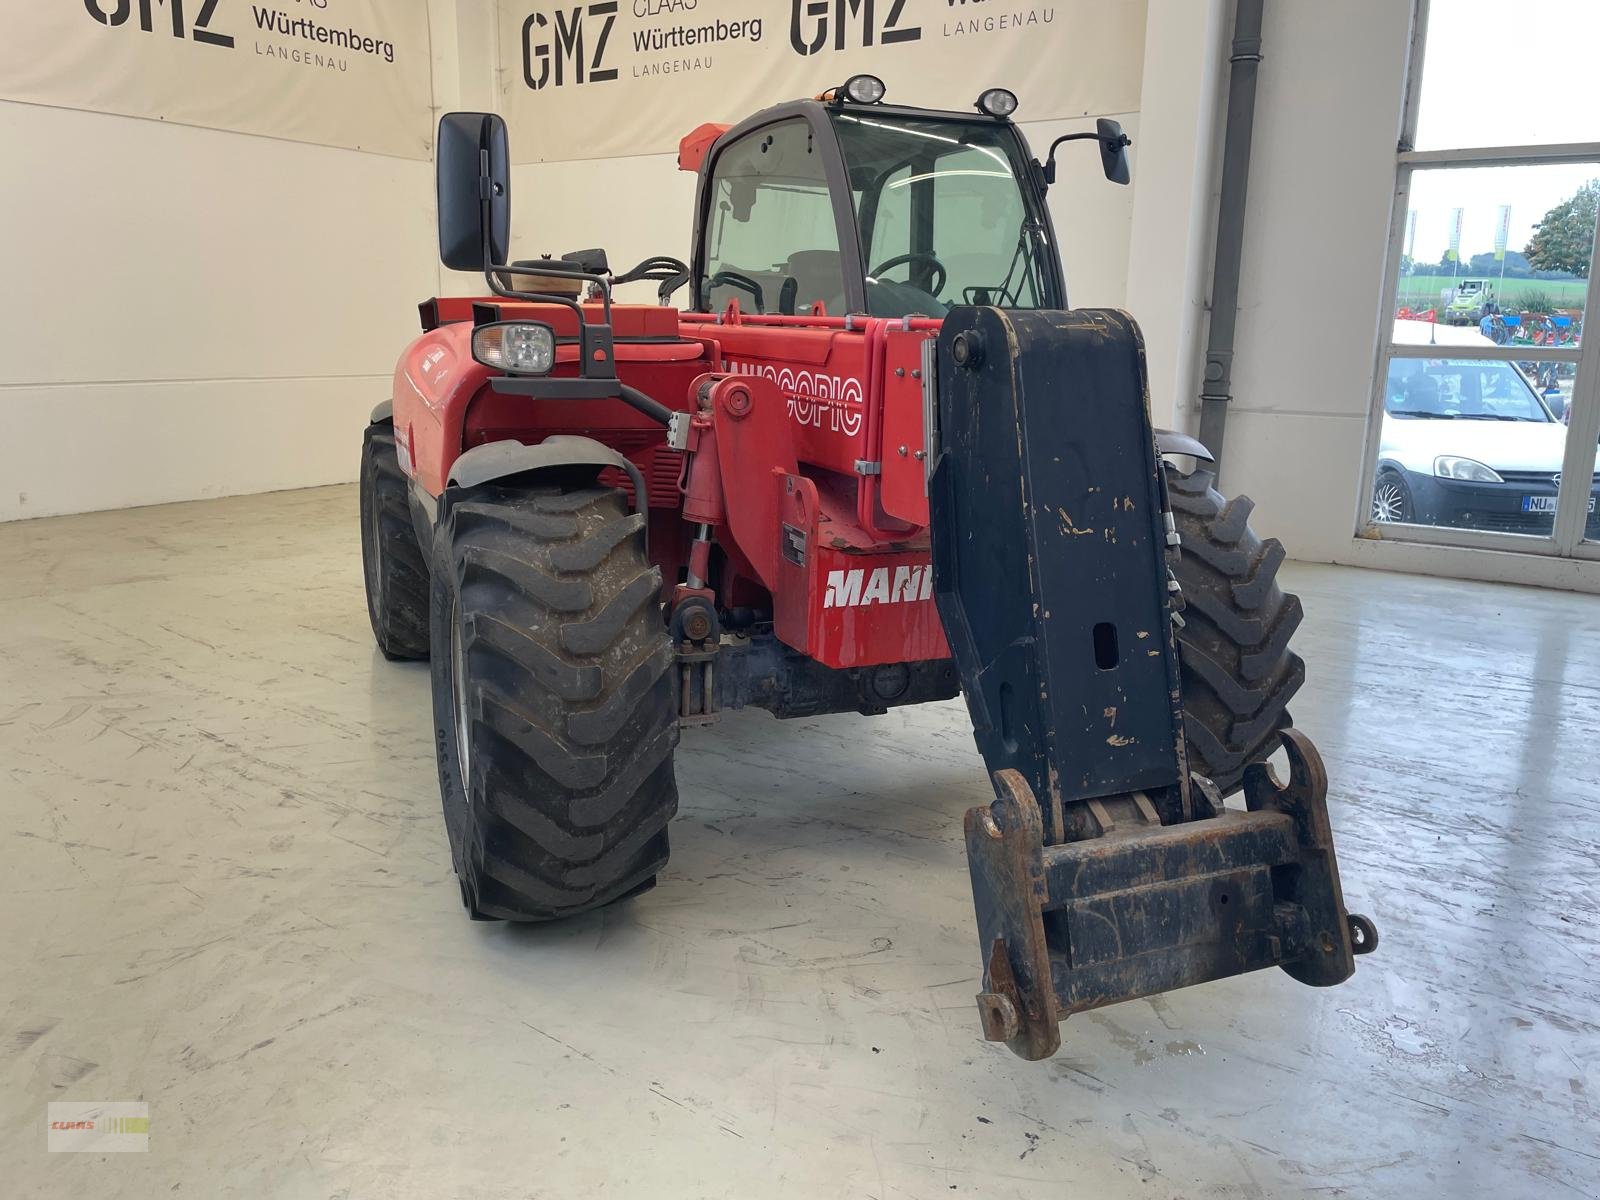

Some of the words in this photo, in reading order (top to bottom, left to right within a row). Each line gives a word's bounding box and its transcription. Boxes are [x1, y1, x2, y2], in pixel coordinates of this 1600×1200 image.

[252, 5, 394, 63] Württemberg
[633, 18, 762, 52] Württemberg
[943, 8, 1055, 37] LANGENAU
[255, 41, 347, 72] LANGENAU
[521, 1, 619, 91] GMZ
[632, 56, 713, 78] LANGENAU
